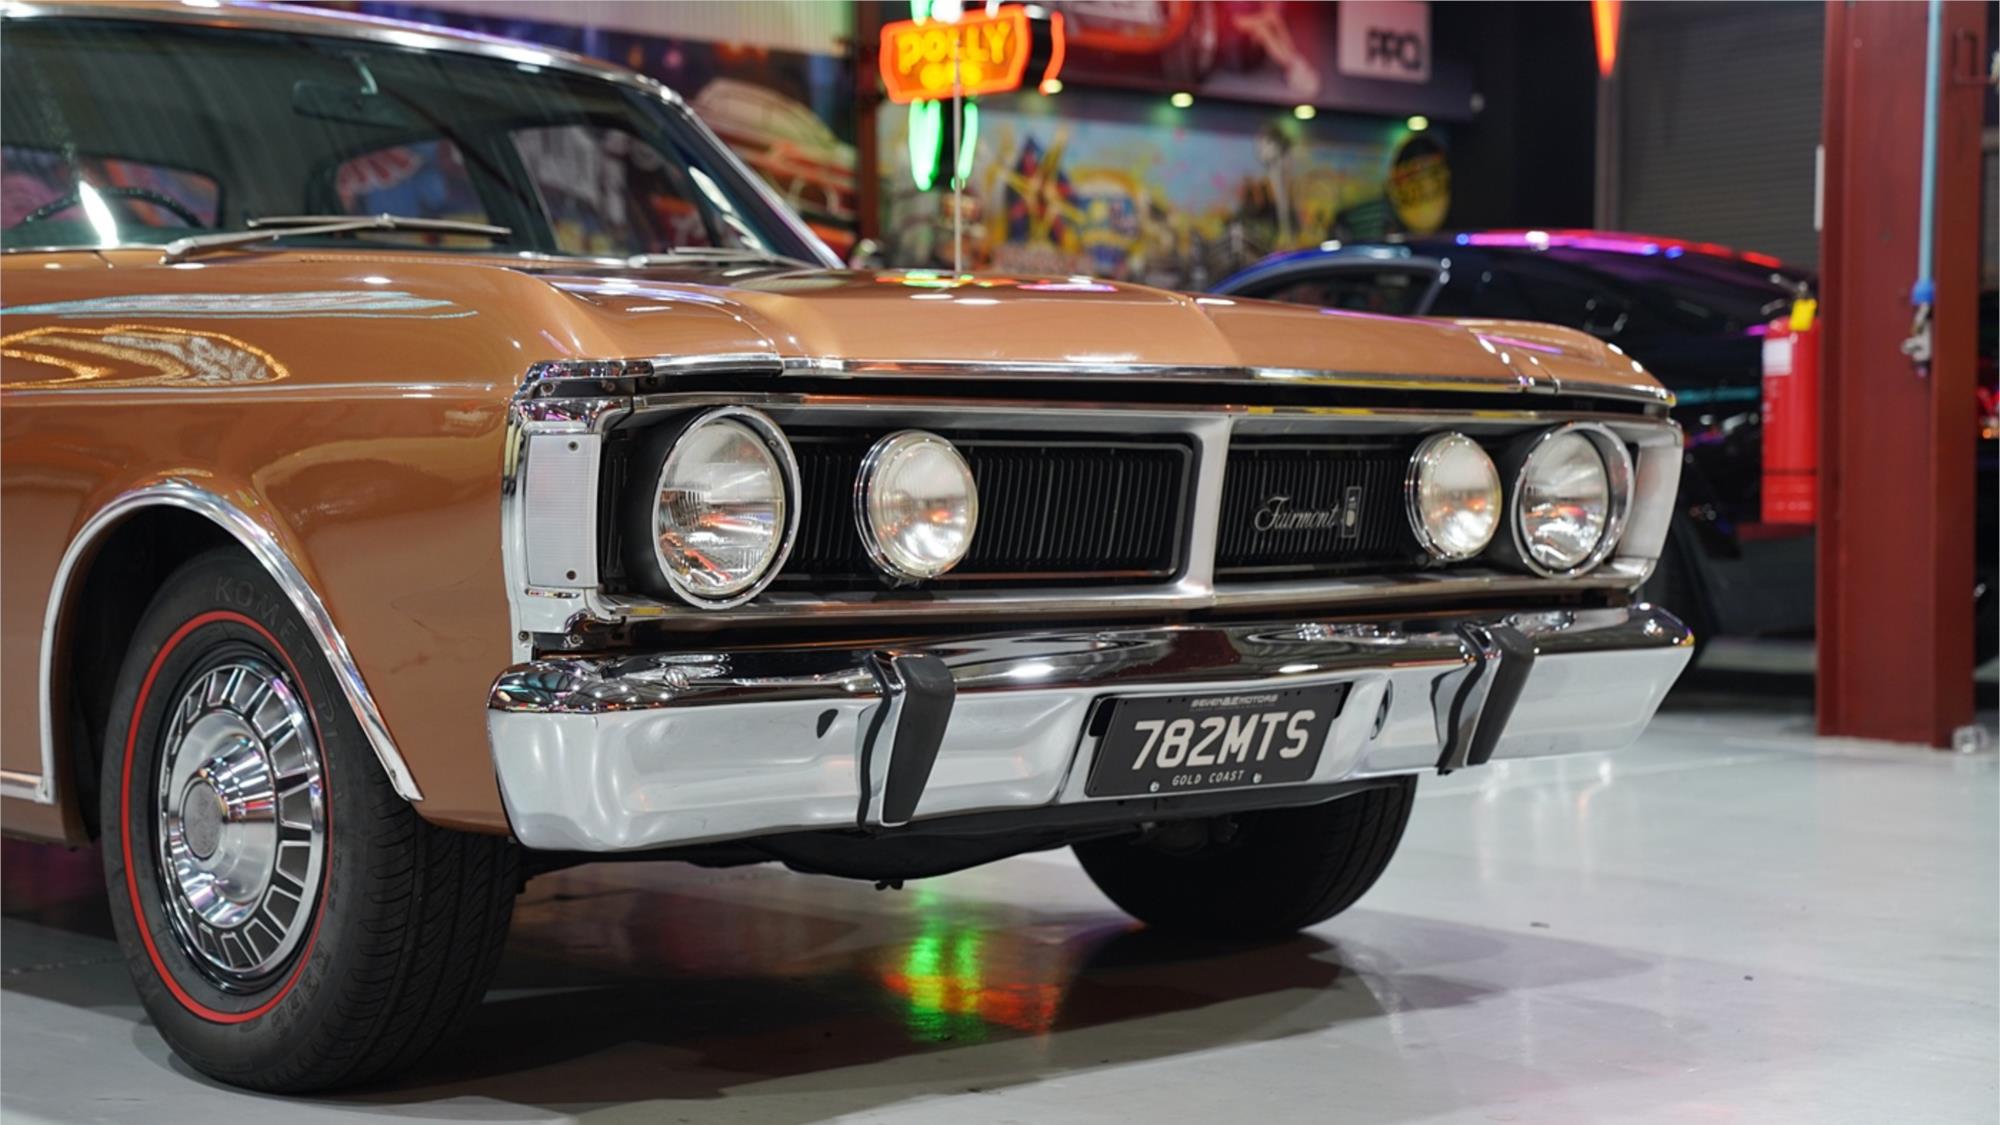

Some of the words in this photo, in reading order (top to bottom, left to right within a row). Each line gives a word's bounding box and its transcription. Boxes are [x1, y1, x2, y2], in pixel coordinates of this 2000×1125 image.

[1254, 496, 1340, 531] Fairmont
[1131, 709, 1317, 771] 782MTS
[1172, 774, 1202, 786] GOLD
[1208, 770, 1245, 784] COAST
